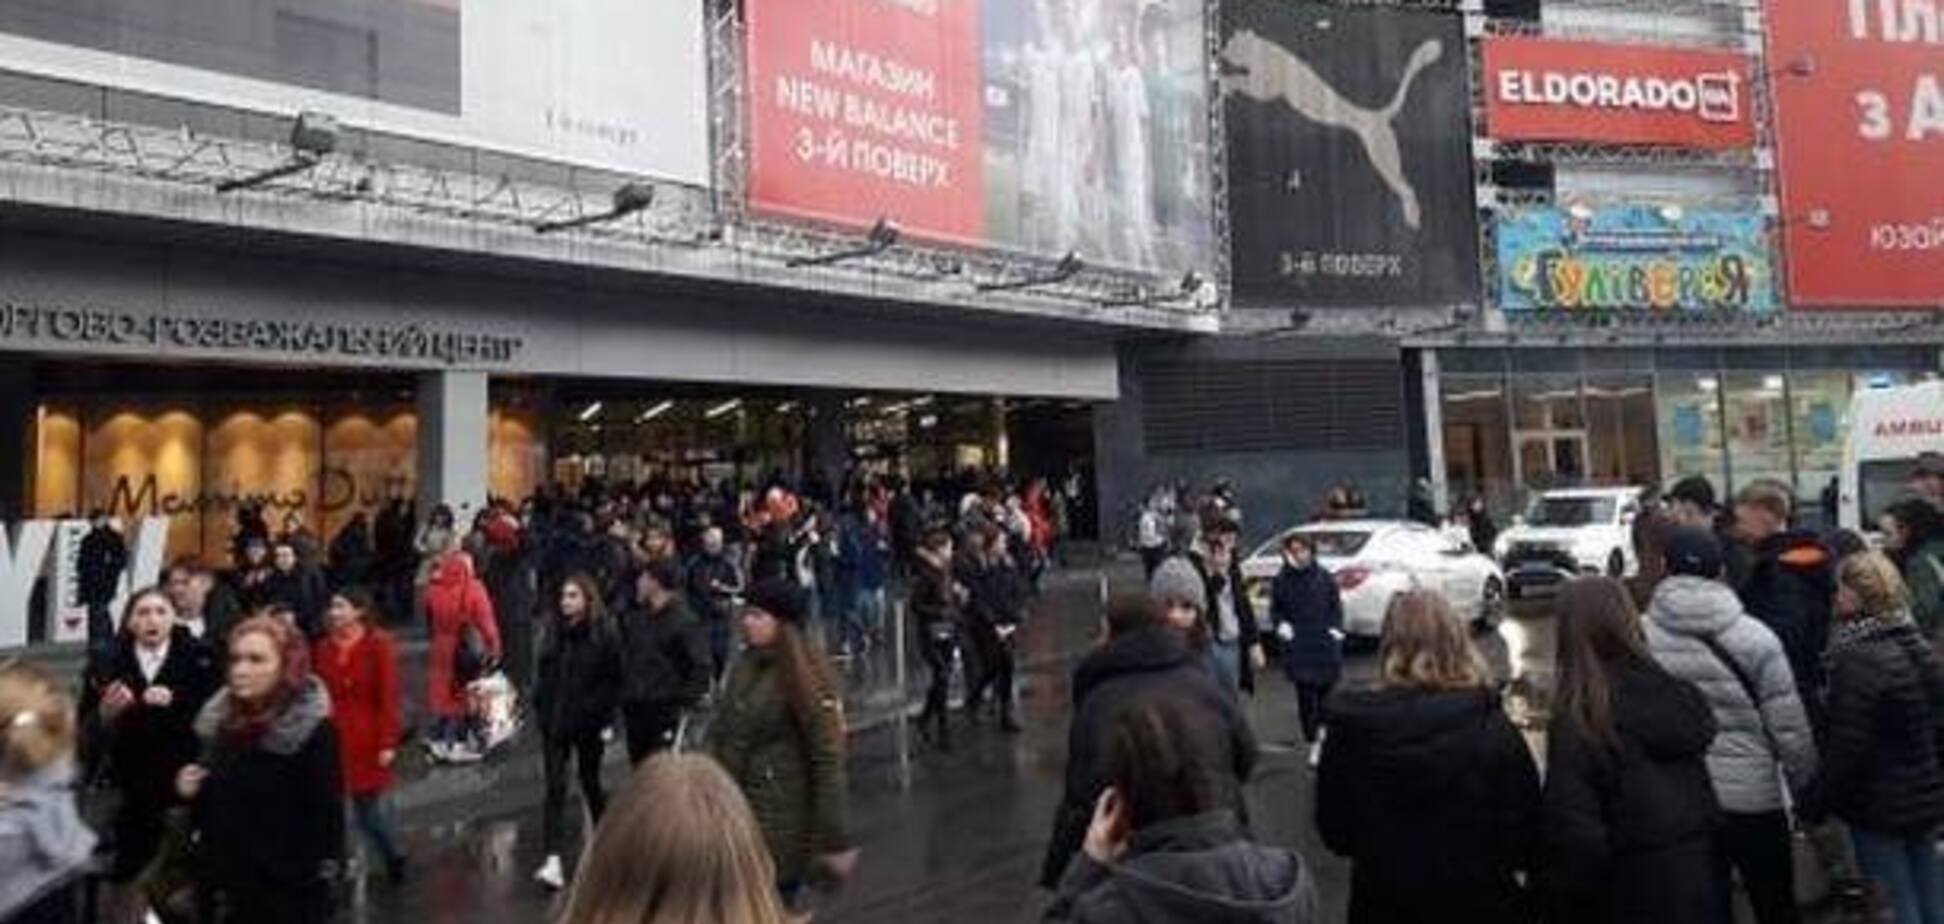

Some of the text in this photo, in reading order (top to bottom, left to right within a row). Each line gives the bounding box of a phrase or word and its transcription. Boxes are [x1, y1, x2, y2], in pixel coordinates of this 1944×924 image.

[811, 40, 934, 100] МАГАЗИН
[1498, 69, 1696, 110] ELDORADO
[777, 75, 959, 150] NEW BALANCE
[853, 139, 953, 188] ПОВЕРХ
